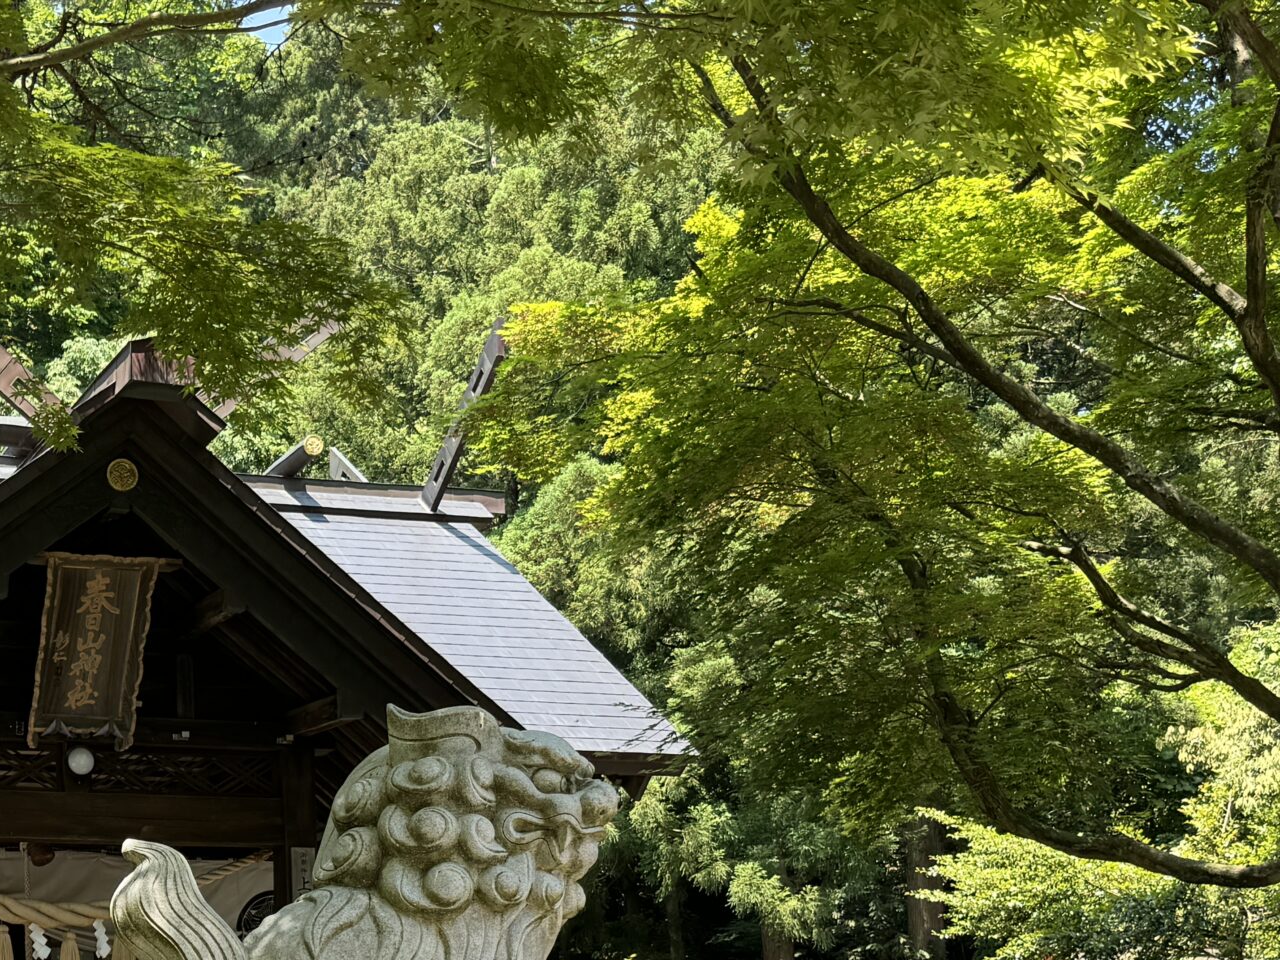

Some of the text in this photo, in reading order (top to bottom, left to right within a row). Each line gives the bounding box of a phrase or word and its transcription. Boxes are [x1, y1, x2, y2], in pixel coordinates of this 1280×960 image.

[64, 569, 120, 710] 春日山神社
